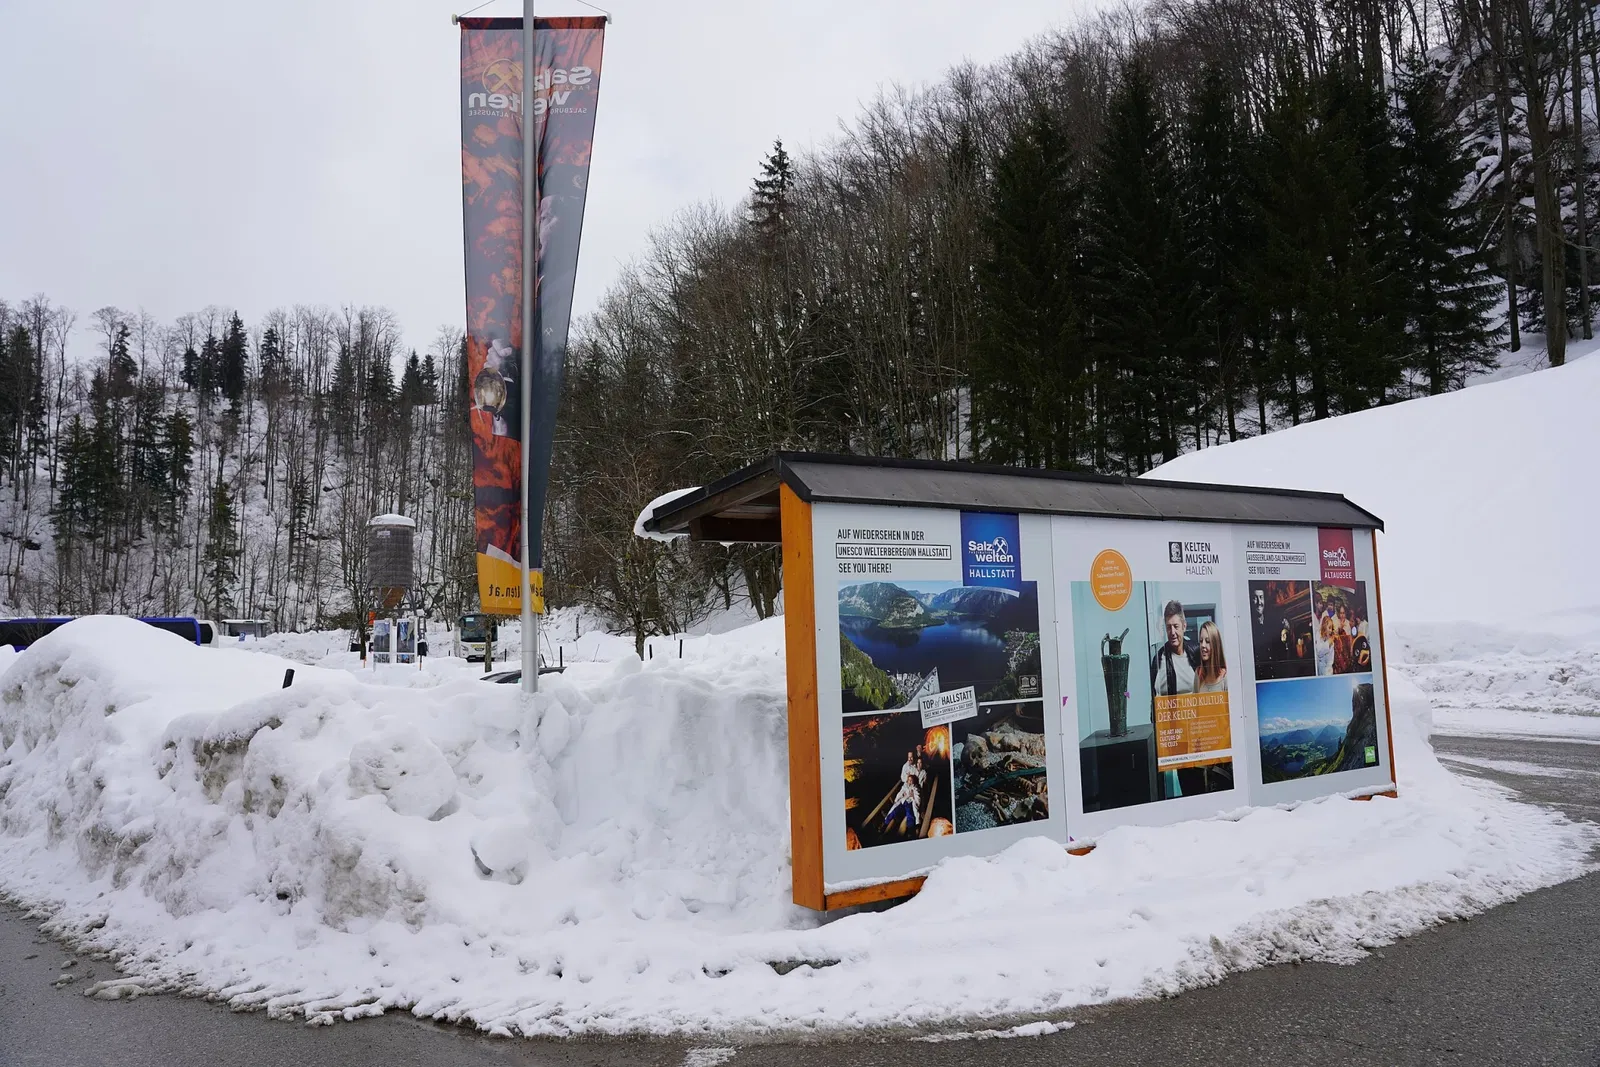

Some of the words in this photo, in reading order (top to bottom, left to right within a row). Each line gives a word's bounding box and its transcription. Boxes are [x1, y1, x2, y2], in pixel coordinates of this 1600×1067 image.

[837, 529, 851, 539] AUF
[852, 529, 901, 540] WIEDERSEHEN
[902, 530, 910, 540] IN
[911, 530, 925, 541] DER
[968, 540, 993, 551] Salz
[1184, 541, 1211, 552] KELTEN
[1256, 541, 1285, 549] WIEDERSEHEN
[838, 546, 863, 556] UNESCO
[864, 547, 917, 556] WELTERBEREGION
[918, 547, 949, 557] HALLSTATT
[975, 549, 1014, 563] welten
[1323, 549, 1338, 558] Salz
[1185, 553, 1220, 564] MUSEUM
[1327, 558, 1351, 567] welten
[838, 562, 852, 573] SEE
[852, 562, 867, 573] YOU
[867, 562, 892, 573] THERE!
[1185, 565, 1213, 575] HALLEIN
[1248, 566, 1257, 574] SEE
[1257, 566, 1265, 574] YOU
[969, 569, 1016, 578] HALLSTATT
[1324, 571, 1352, 579] ALTAUSSEE
[922, 699, 934, 710] TOP
[941, 690, 973, 706] HALLSTATT
[1157, 698, 1180, 710] KUNST
[1181, 696, 1198, 708] UND
[1199, 694, 1224, 706] KULTUR
[1157, 711, 1171, 722] DER
[1172, 709, 1197, 720] KELTEN
